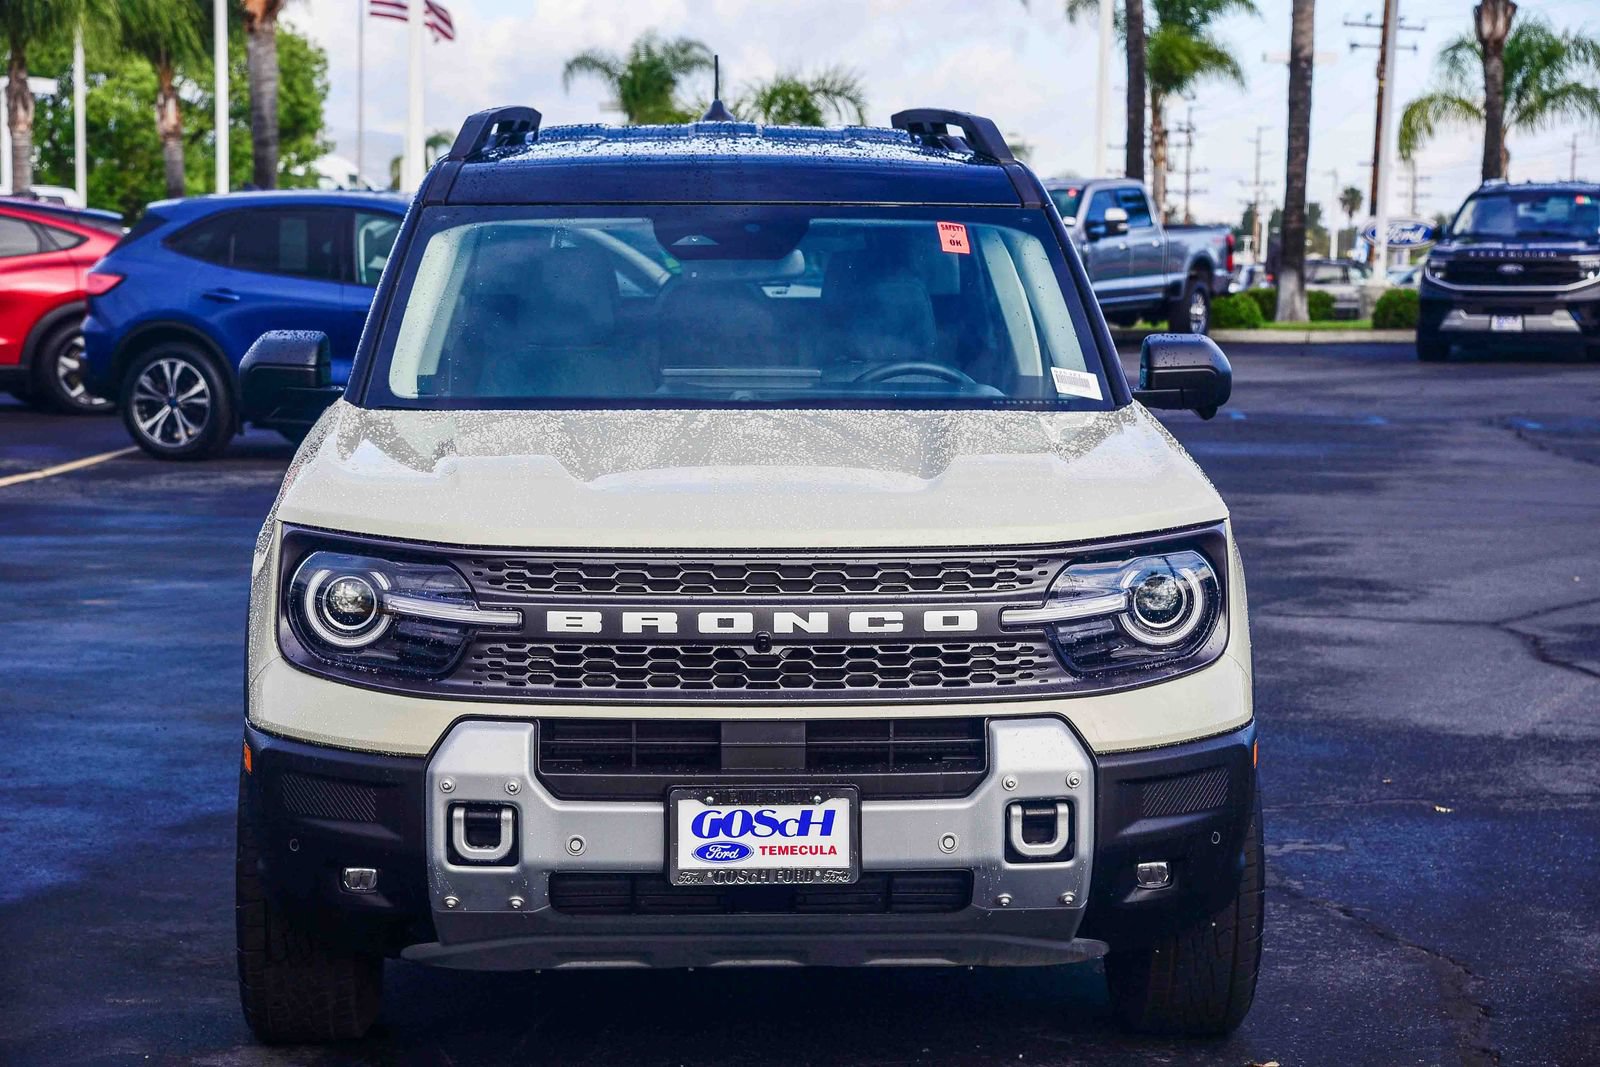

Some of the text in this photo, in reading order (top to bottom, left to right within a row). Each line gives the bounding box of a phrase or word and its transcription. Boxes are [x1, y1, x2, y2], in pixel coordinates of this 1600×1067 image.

[940, 223, 964, 232] SAFETY
[949, 239, 962, 247] OK
[546, 610, 978, 634] BRONCO
[705, 844, 740, 860] Ford
[759, 845, 837, 856] TEMECULA
[677, 871, 706, 884] Ford
[774, 868, 814, 884] FORD
[822, 869, 851, 883] Ford
